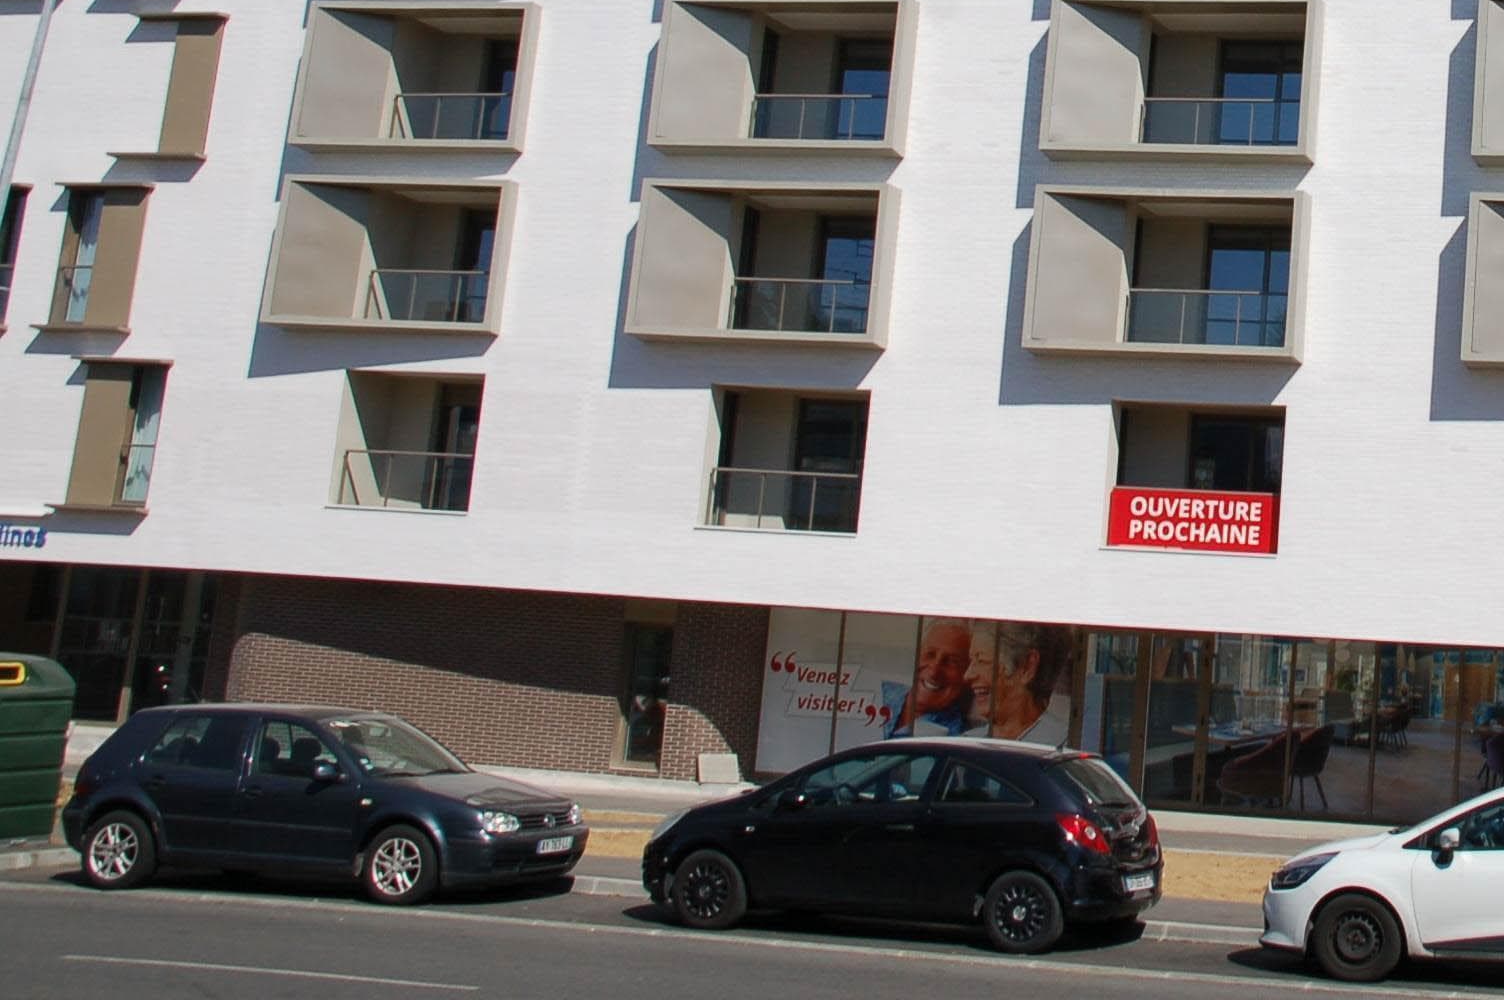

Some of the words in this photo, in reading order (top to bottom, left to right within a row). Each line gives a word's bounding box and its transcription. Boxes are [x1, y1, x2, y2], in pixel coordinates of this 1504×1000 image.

[1130, 496, 1262, 522] OUVERTURE
[1128, 519, 1260, 546] PROCHAINE
[797, 666, 850, 685] Venez
[797, 693, 855, 713] visiter
